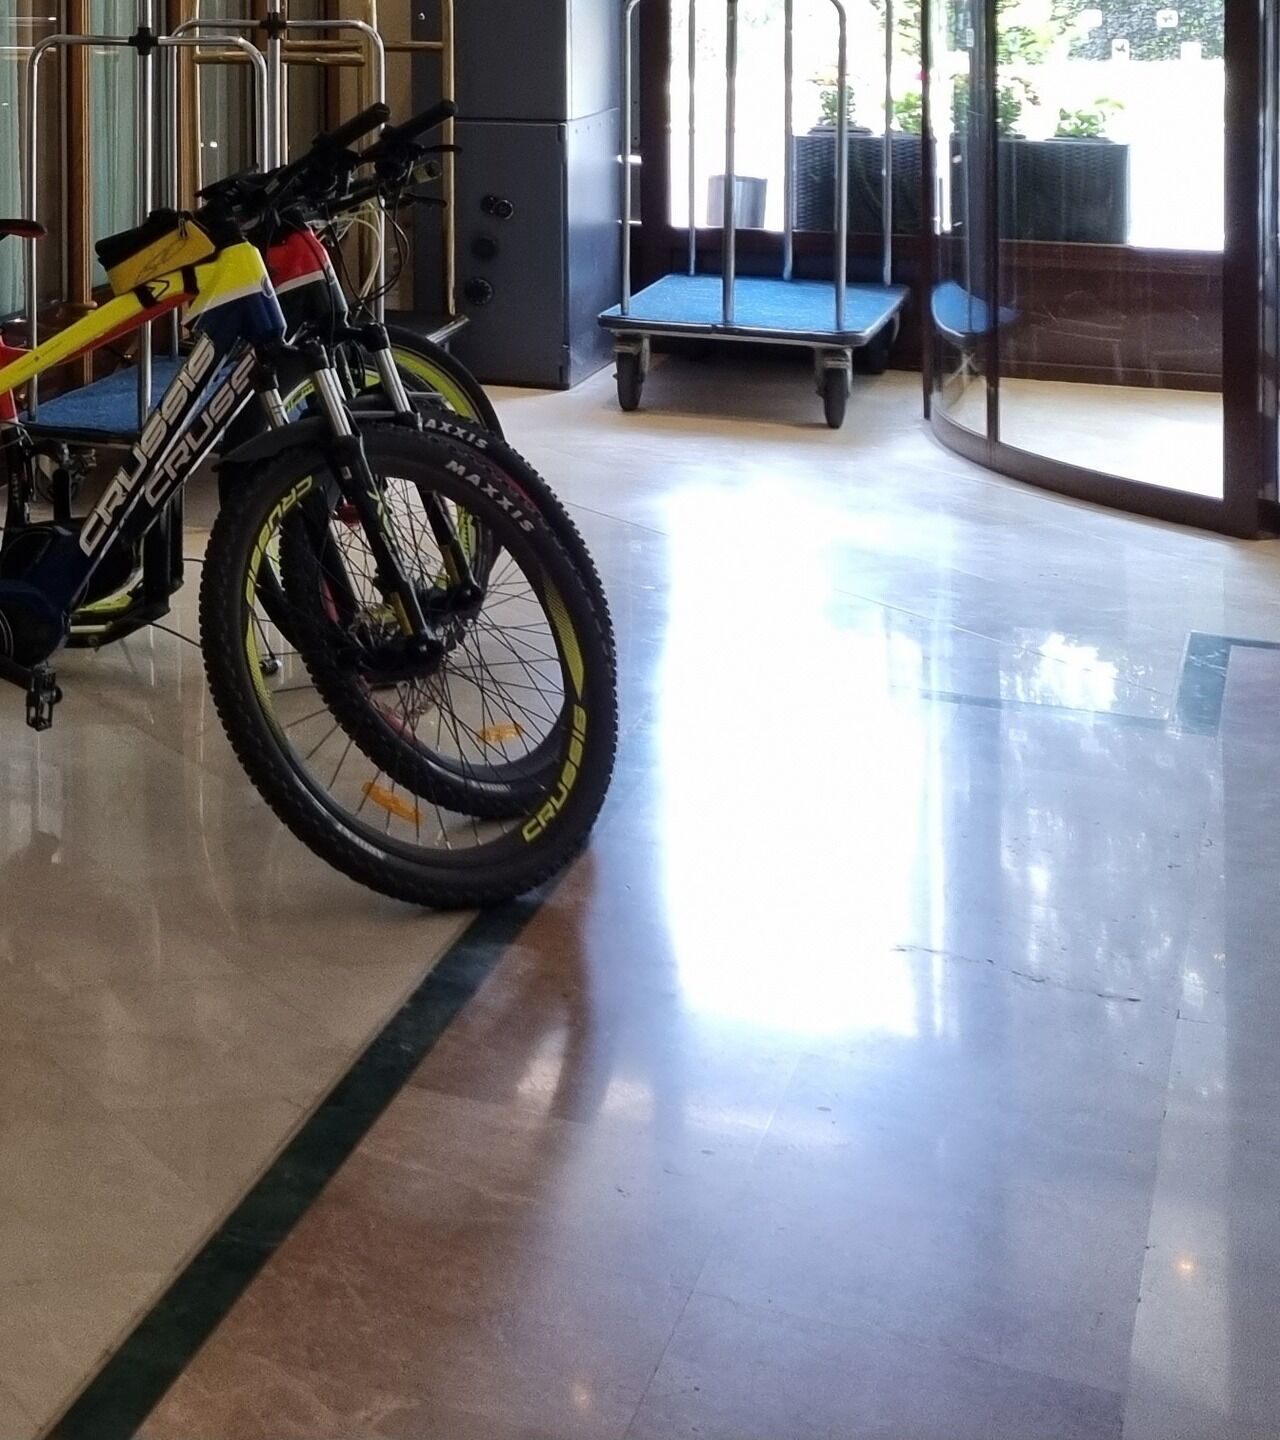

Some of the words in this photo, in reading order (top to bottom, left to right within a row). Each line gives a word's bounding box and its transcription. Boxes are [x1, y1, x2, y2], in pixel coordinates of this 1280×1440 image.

[79, 332, 216, 557] CRUSSIS
[423, 417, 489, 449] AXXIS
[444, 459, 536, 533] MAXXIS
[246, 474, 313, 607] CRUSSIS
[521, 703, 588, 844] CRUSSIS
